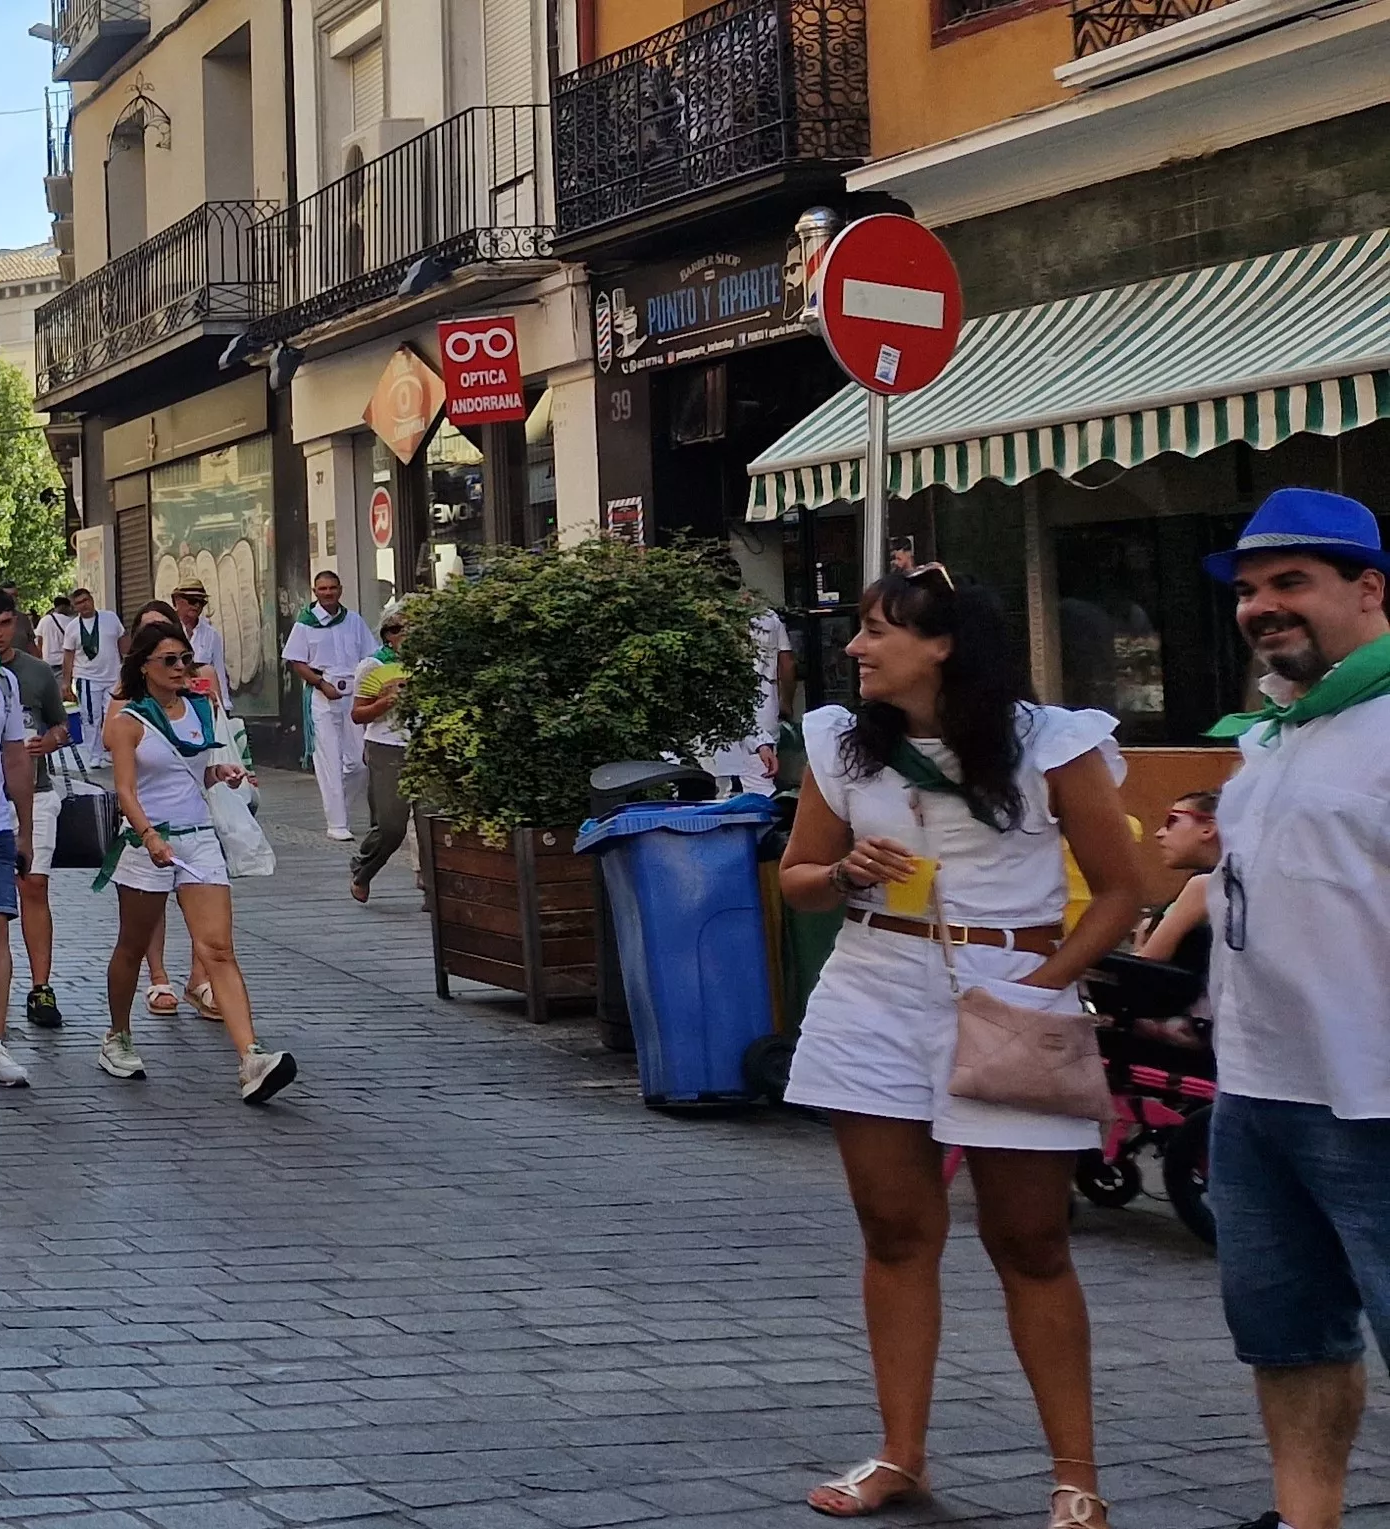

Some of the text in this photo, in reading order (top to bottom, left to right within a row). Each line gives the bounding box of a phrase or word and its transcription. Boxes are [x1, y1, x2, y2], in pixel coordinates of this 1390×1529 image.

[679, 254, 714, 283] BARBER
[715, 252, 741, 268] SHOP
[647, 263, 781, 336] PUNTO Y APARTE
[460, 368, 507, 388] OPTICA
[451, 392, 522, 415] ANDORRANA
[611, 389, 631, 422] 39
